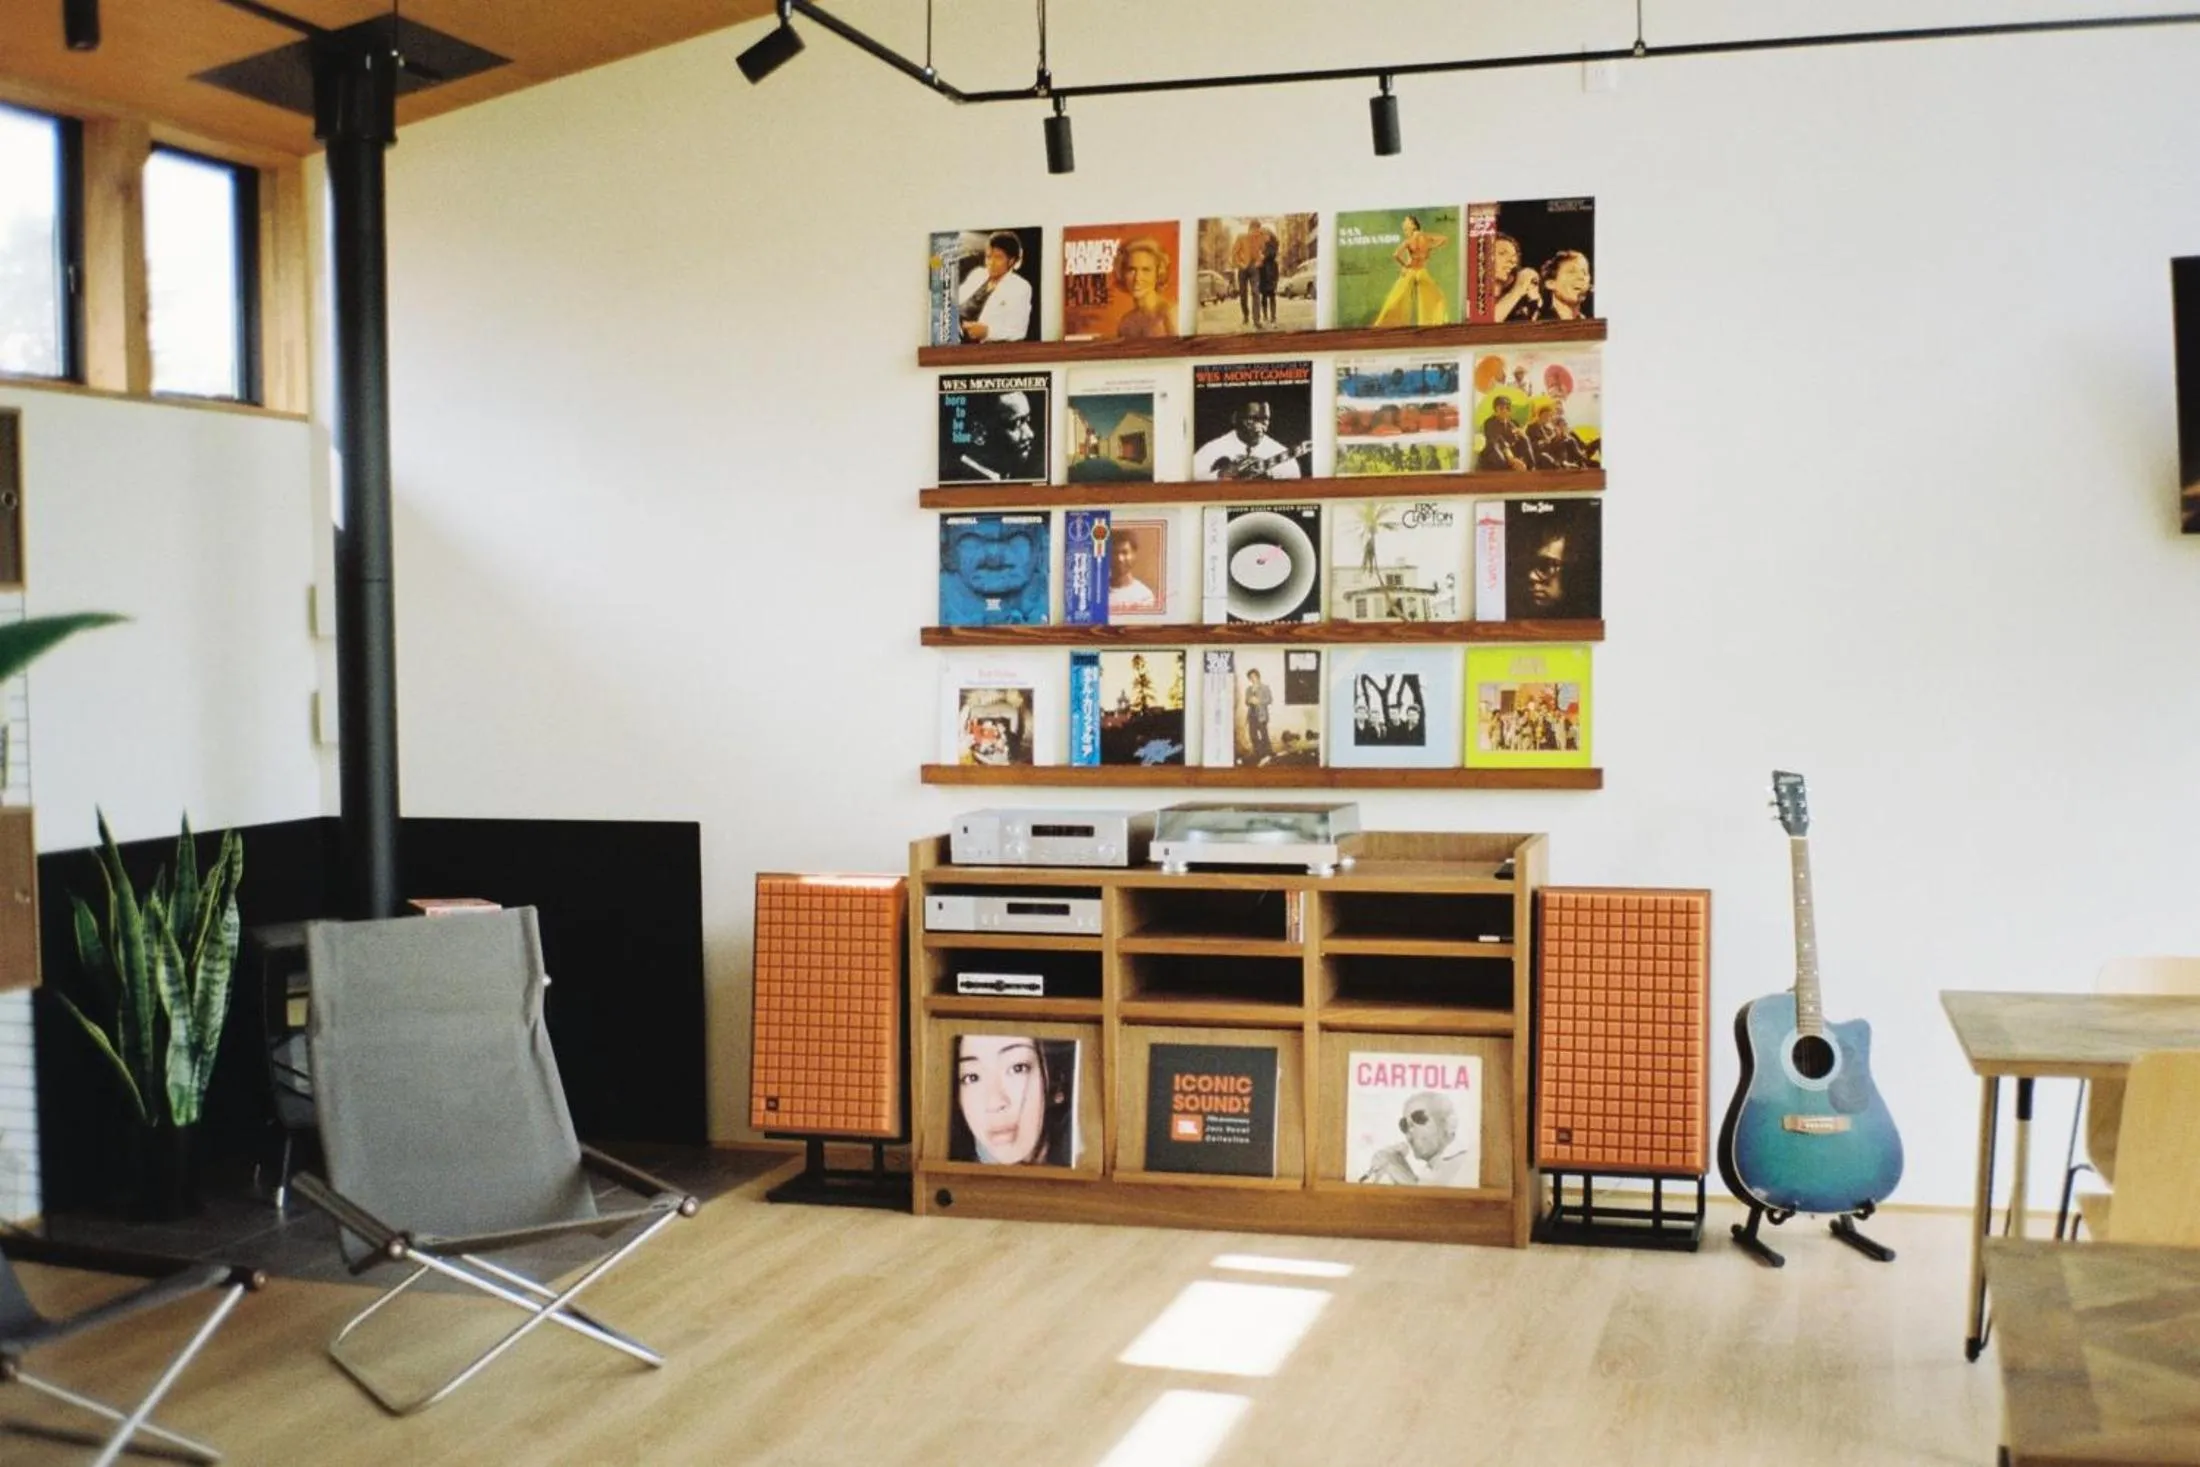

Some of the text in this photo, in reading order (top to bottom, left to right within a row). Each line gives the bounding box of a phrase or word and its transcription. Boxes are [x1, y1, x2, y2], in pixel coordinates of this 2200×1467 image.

[942, 376, 1048, 390] WES MONTGOMERY
[1223, 368, 1309, 381] MONTGOMERY
[956, 405, 966, 418] to
[1174, 1073, 1253, 1094] ICONIC
[1357, 1062, 1470, 1090] CARTOLA
[1173, 1093, 1252, 1114] SOUND!
